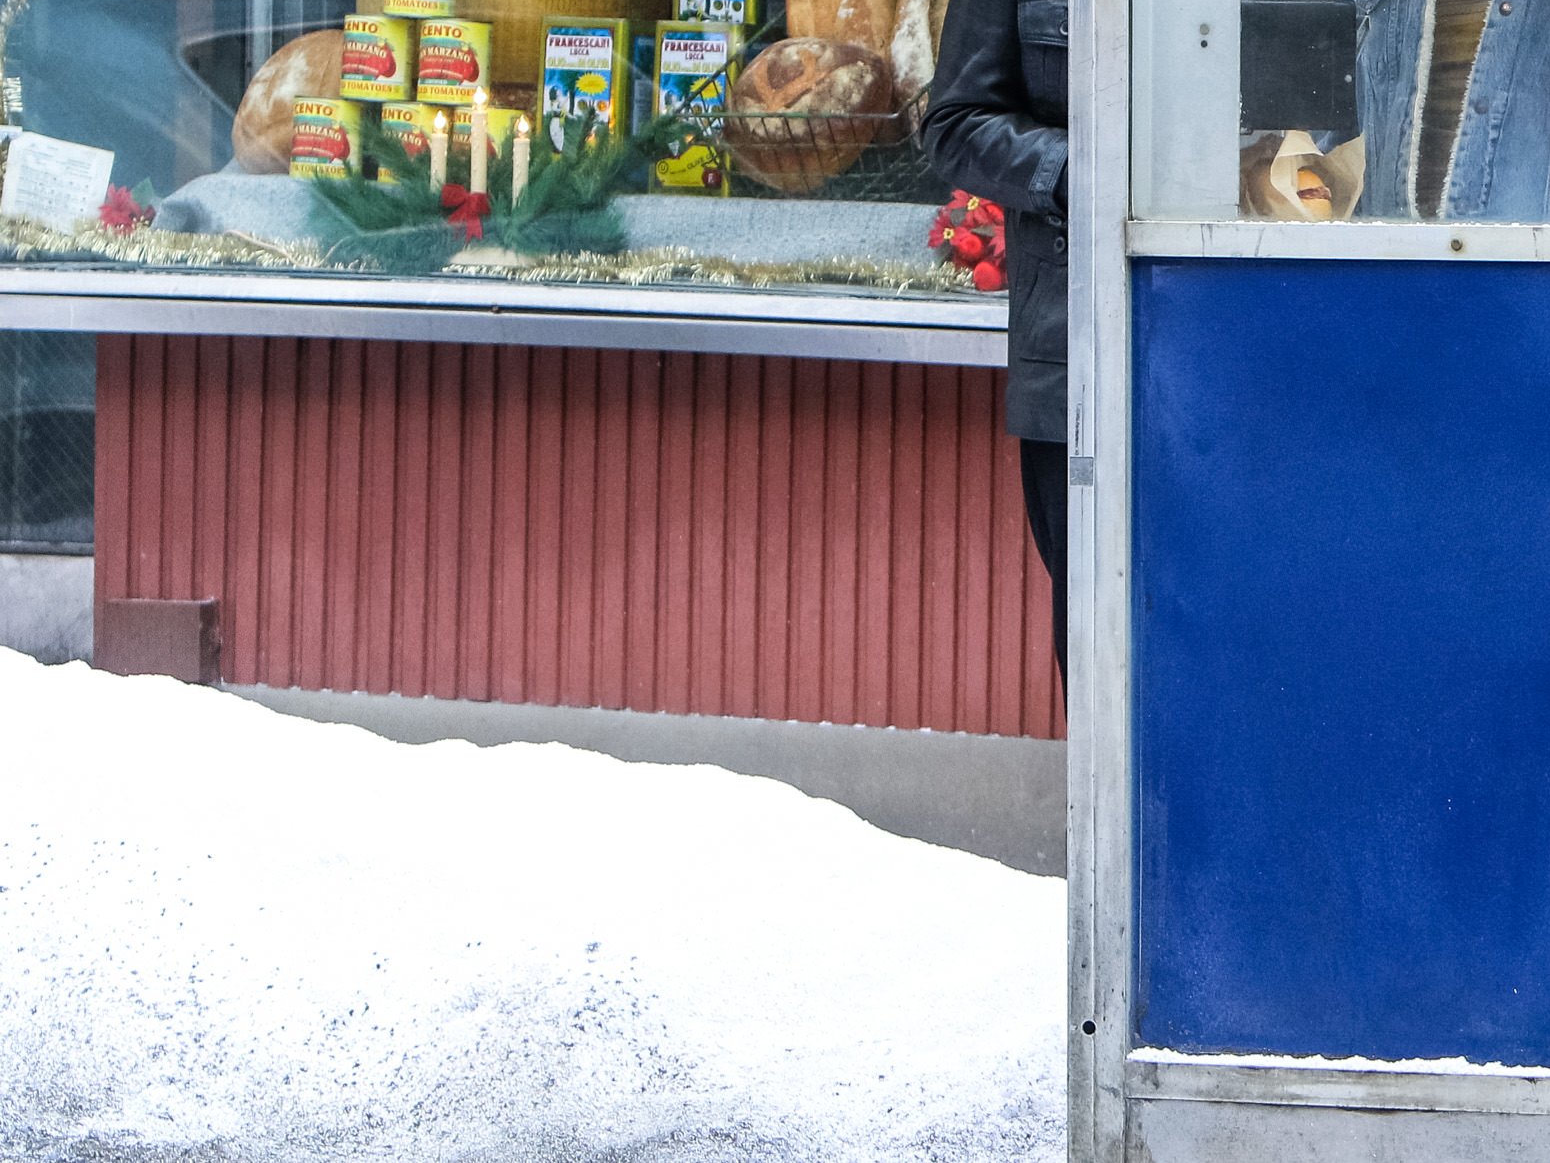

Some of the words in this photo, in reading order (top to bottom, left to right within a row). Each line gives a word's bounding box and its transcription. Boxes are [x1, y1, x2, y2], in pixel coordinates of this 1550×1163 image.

[345, 20, 378, 34] ENTO
[422, 25, 463, 39] CENTO
[427, 46, 472, 63] MARZANO
